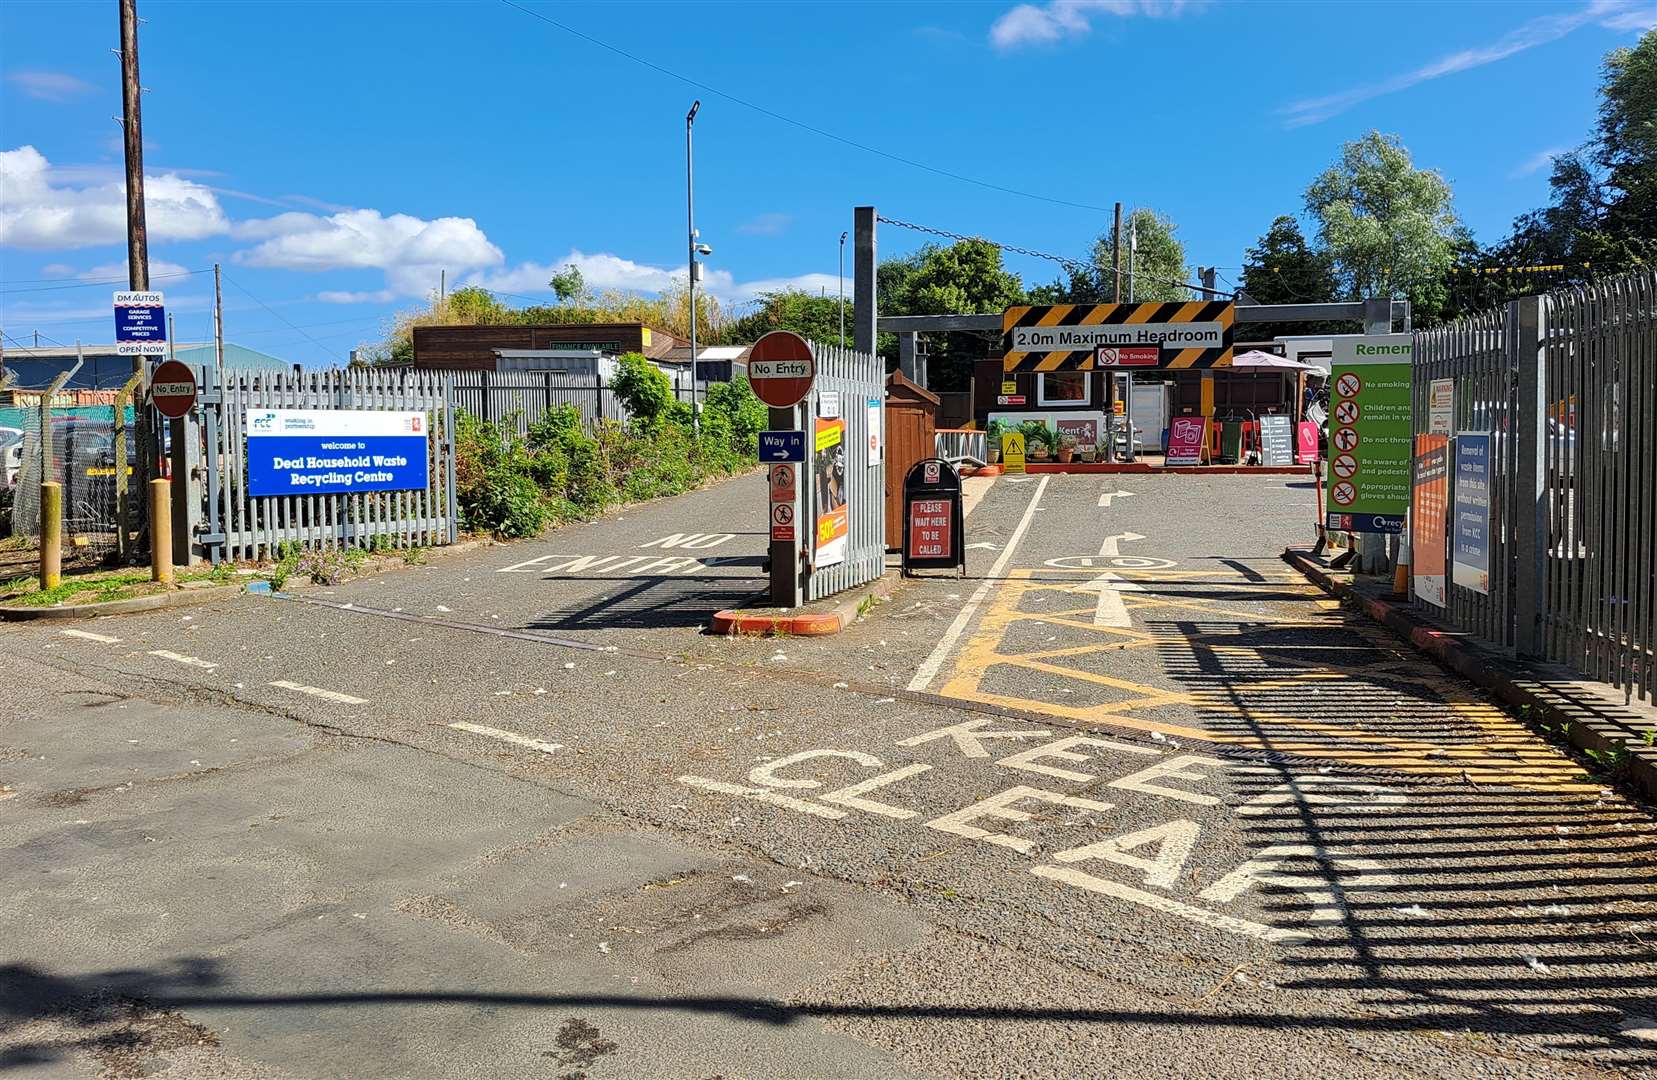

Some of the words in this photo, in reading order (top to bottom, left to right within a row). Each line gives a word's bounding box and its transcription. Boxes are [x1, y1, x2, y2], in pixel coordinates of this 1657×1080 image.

[132, 294, 160, 302] AUTOS
[1017, 332, 1054, 346] 2.0m
[1059, 331, 1132, 345] Maximum
[1137, 329, 1218, 343] Headroom
[143, 345, 164, 353] NOW
[1129, 352, 1158, 361] Smoking
[755, 364, 770, 374] No
[776, 363, 806, 375] Entry
[170, 384, 190, 394] Entry
[1377, 381, 1410, 389] smoking
[1059, 426, 1080, 436] Kent
[321, 442, 356, 450] welcome
[357, 442, 366, 450] to
[764, 436, 785, 447] Way
[790, 436, 800, 445] in
[273, 456, 304, 469] Deal
[306, 456, 371, 468] Household
[372, 455, 408, 467] Waste
[290, 472, 353, 486] Recycling
[354, 471, 393, 483] Centre
[1361, 483, 1406, 491] Appropriate
[1360, 492, 1385, 500] gloves
[920, 503, 942, 513] PLEASE
[915, 517, 930, 527] WAIT
[930, 516, 947, 526] HERE
[921, 531, 930, 540] TO
[931, 531, 939, 540] BE
[639, 533, 737, 549] NO
[919, 544, 942, 555] CALLED
[496, 555, 744, 574] ENTRY
[897, 719, 1409, 816] KEEP
[749, 748, 1399, 927] CLEAR
